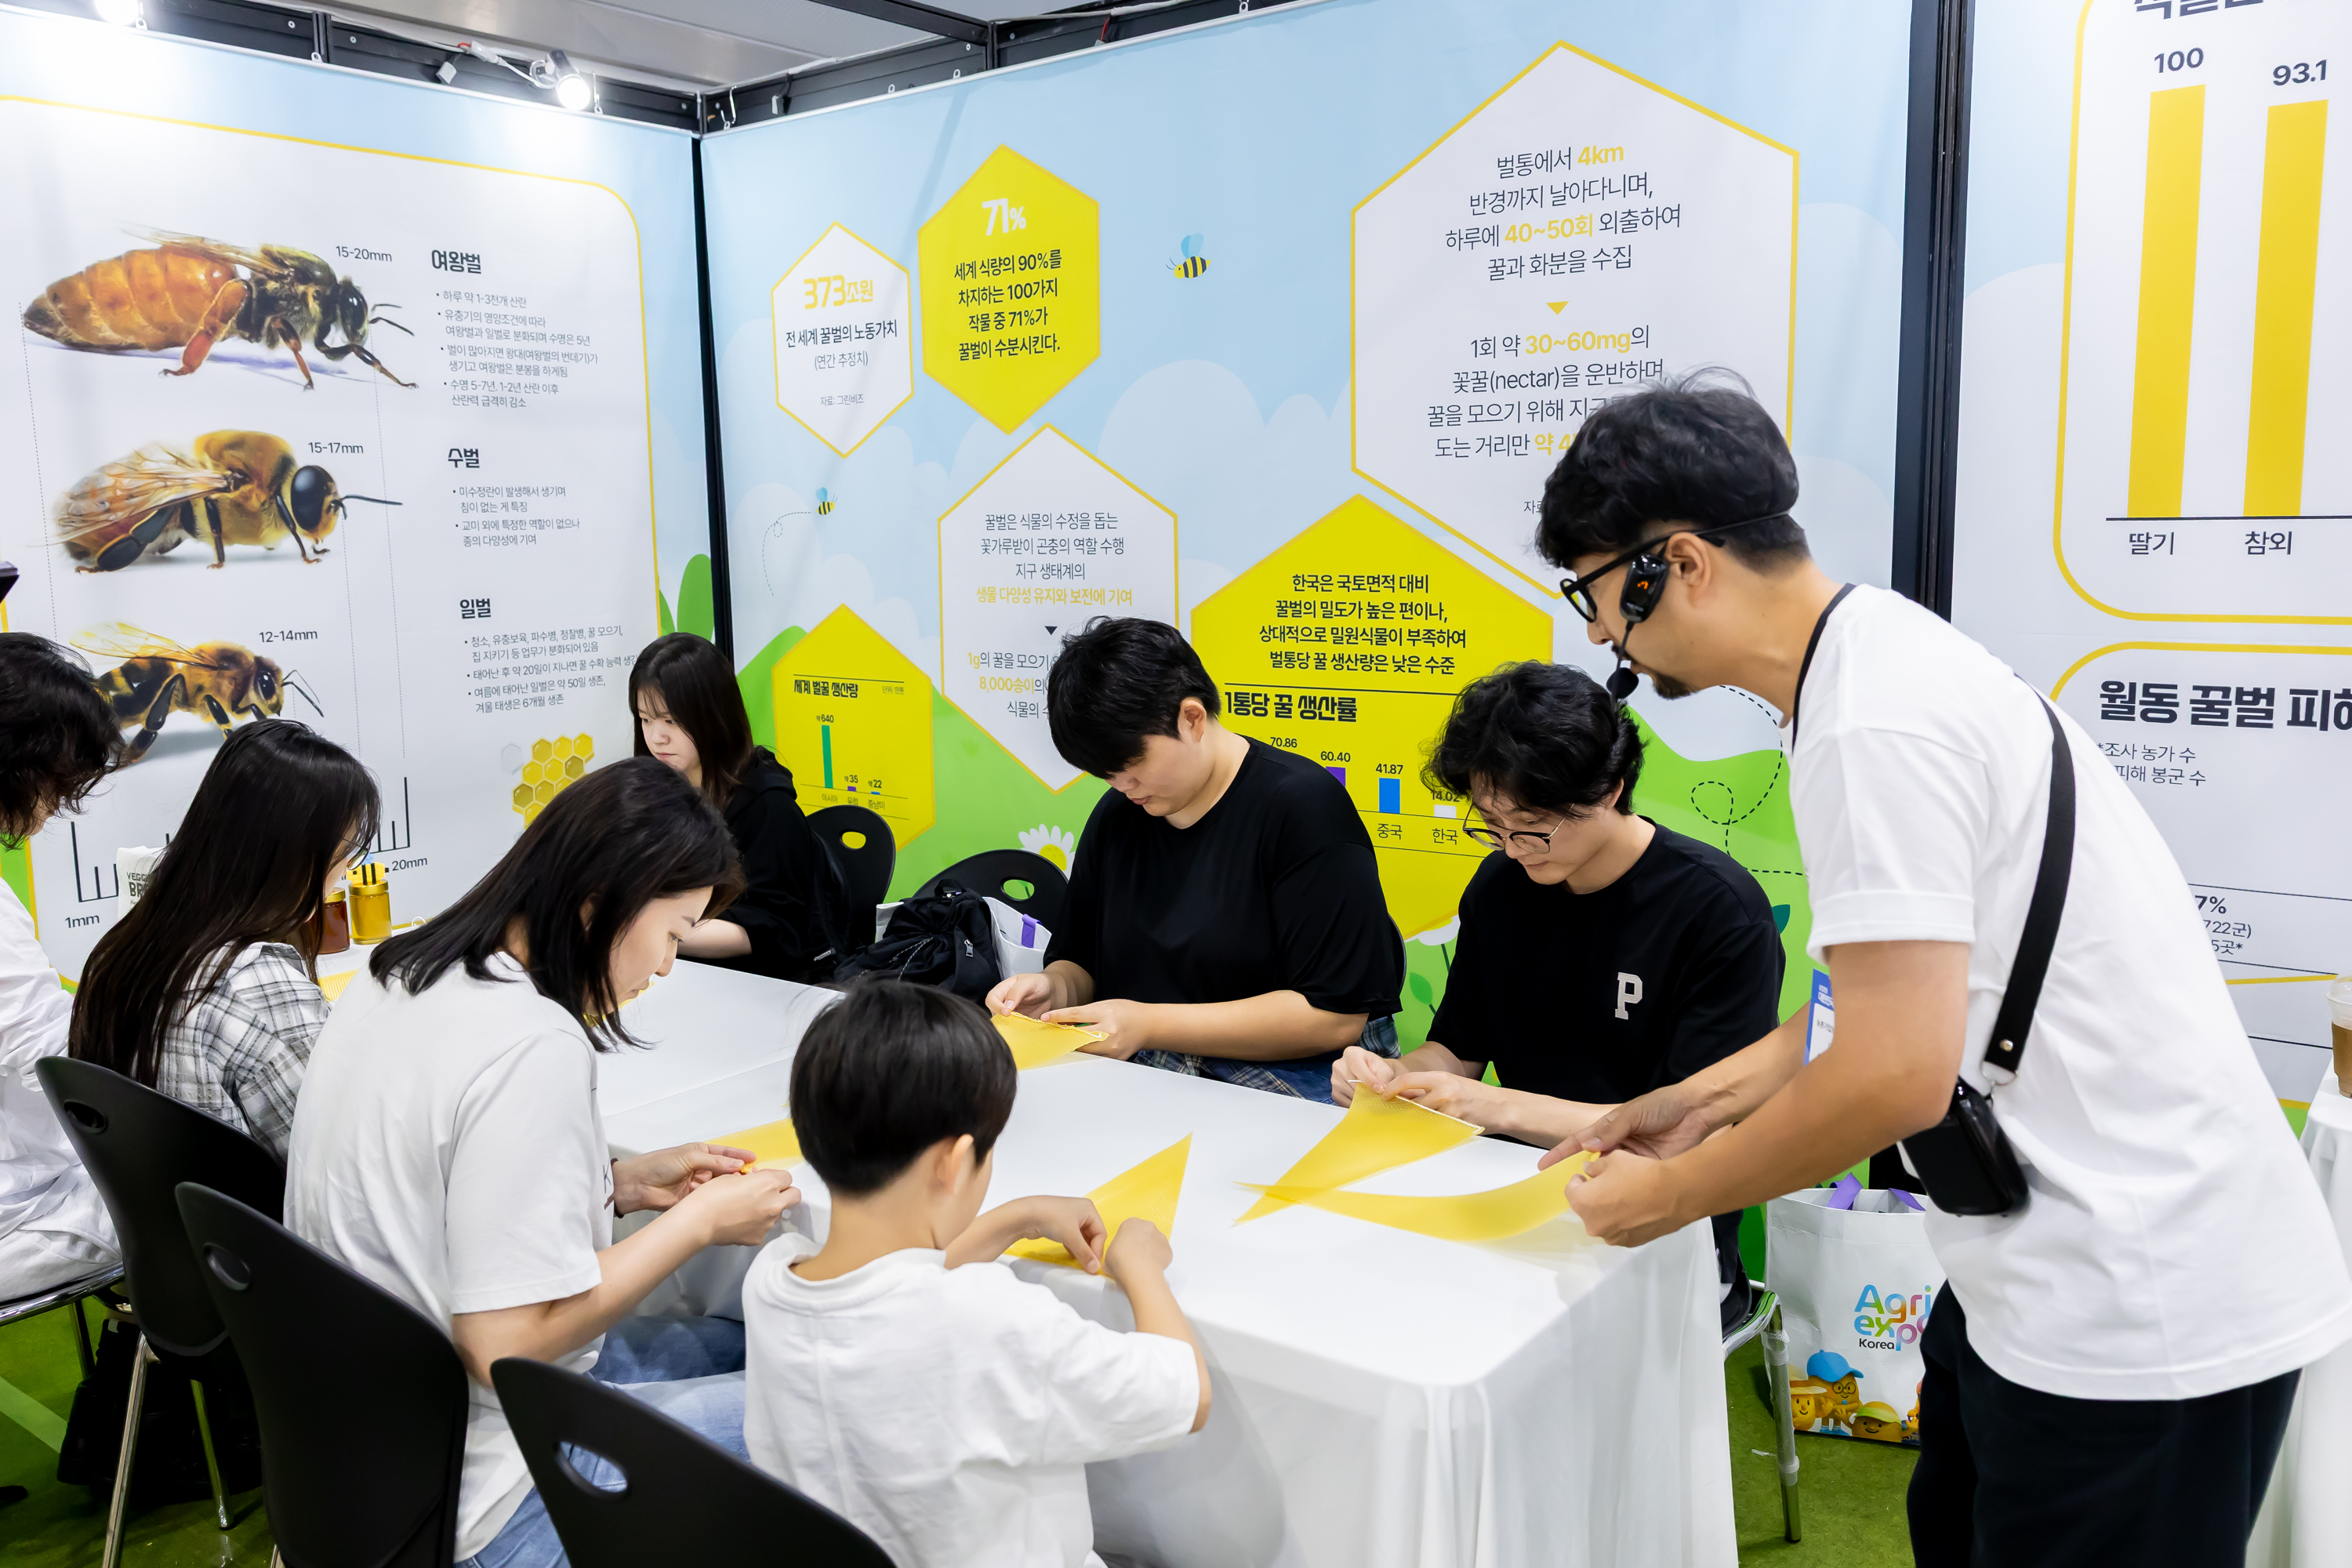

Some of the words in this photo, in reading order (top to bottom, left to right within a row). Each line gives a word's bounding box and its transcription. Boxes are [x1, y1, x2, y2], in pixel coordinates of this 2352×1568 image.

[2154, 48, 2204, 73] 100
[2273, 60, 2327, 85] 93.1
[1497, 147, 1571, 179] 벌통에서
[1577, 145, 1624, 165] 4km
[1470, 185, 1543, 216] 반경까지
[1551, 172, 1653, 206] 날아다니며,
[982, 198, 1026, 236] 71%
[1446, 224, 1499, 251] 하루에
[1504, 213, 1593, 243] 40~50회
[1599, 204, 1680, 234] 외출하여
[336, 245, 392, 262] 15-20mm
[431, 250, 481, 274] 여왕벌
[1488, 256, 1525, 281] 꿀과
[1530, 250, 1587, 276] 화분을
[1592, 245, 1631, 270] 수집
[954, 260, 977, 281] 세계
[979, 255, 1014, 277] 식량의
[1018, 249, 1062, 271] 90%를
[443, 290, 463, 303] 하루
[464, 292, 474, 303] 약
[510, 296, 527, 309] 산란
[804, 274, 873, 310] 373조원
[959, 285, 1004, 307] 차지하는
[1007, 278, 1058, 299] 100가지
[969, 313, 991, 332] 작물
[993, 311, 1006, 330] 중
[1008, 307, 1048, 327] 71%가
[445, 325, 483, 339] 여왕벌과
[485, 328, 511, 340] 일벌로
[786, 331, 796, 348] 전
[798, 328, 818, 346] 세계
[820, 325, 851, 344] 꿀벌의
[855, 319, 897, 339] 노동가치
[1471, 336, 1496, 358] 1회
[1502, 335, 1521, 357] 약
[1525, 325, 1650, 354] 30~60mg의
[959, 339, 992, 361] 꿀벌이
[995, 333, 1060, 358] 수분시킨다.
[815, 354, 836, 371] (연간
[838, 350, 868, 368] 추정치)
[1453, 365, 1581, 394] 꽃꿀(nectar)을
[1428, 405, 1463, 427] 꿀을
[1468, 401, 1520, 423] 모으기
[1526, 399, 1563, 422] 위해
[308, 442, 364, 453] 15-17mm
[1435, 437, 1471, 458] 도는
[1475, 434, 1530, 457] 거리만
[1534, 433, 1554, 456] 약
[448, 448, 480, 468] 수벌
[459, 486, 503, 498] 미수정란이
[505, 486, 539, 498] 발생해서
[541, 486, 565, 497] 생기며
[460, 502, 478, 514] 침이
[480, 502, 498, 513] 없는
[500, 502, 509, 512] 게
[511, 501, 528, 513] 특징
[985, 514, 1017, 531] 꿀벌은
[1020, 513, 1052, 530] 식물의
[1056, 513, 1091, 530] 수정을
[1094, 513, 1118, 529] 돕는
[463, 535, 481, 547] 종의
[483, 535, 518, 546] 다양성에
[520, 534, 536, 545] 기여
[981, 538, 1033, 555] 꽃가루받이
[1036, 538, 1069, 555] 곤충의
[1073, 537, 1098, 555] 역할
[1100, 537, 1123, 555] 수행
[2129, 532, 2174, 555] 딸기
[2245, 531, 2292, 555] 참외
[1016, 563, 1037, 579] 지구
[1040, 563, 1085, 580] 생태계의
[1292, 574, 1334, 592] 한국은
[1337, 574, 1395, 593] 국토면적
[1399, 575, 1428, 593] 대비
[976, 586, 997, 603] 생물
[1000, 586, 1031, 604] 다양성
[1033, 587, 1068, 604] 유지와
[1069, 588, 1105, 605] 보전에
[1109, 588, 1132, 606] 기여
[459, 598, 491, 619] 일벌
[1276, 600, 1316, 619] 꿀벌의
[1320, 601, 1363, 619] 밀도가
[1366, 601, 1396, 619] 높은
[1399, 601, 1447, 623] 편이나,
[259, 630, 318, 643] 12-14mm
[588, 627, 595, 638] 꿀
[1259, 625, 1327, 644] 상대적으로
[1330, 626, 1402, 646] 밀원식물이
[1406, 629, 1465, 648] 부족하여
[472, 652, 481, 662] 집
[483, 649, 509, 661] 지키기
[511, 648, 520, 659] 등
[521, 646, 546, 659] 업무가
[549, 643, 581, 656] 분화되어
[583, 641, 598, 652] 있음
[967, 652, 990, 670] 1g의
[993, 652, 1014, 669] 꿀을
[1017, 655, 1049, 671] 모으기
[1270, 651, 1311, 670] 벌통당
[1313, 652, 1327, 670] 꿀
[1330, 653, 1388, 672] 생산량은
[1392, 655, 1421, 673] 낮은
[1425, 656, 1455, 675] 수준
[794, 679, 811, 695] 세계
[812, 681, 829, 696] 벌꿀
[831, 682, 858, 699] 생산량
[979, 676, 1045, 695] 8,000송이의
[1007, 701, 1039, 719] 식물의
[1225, 691, 1270, 717] 1통당
[1274, 694, 1293, 719] 꿀
[1298, 695, 1357, 722] 생산률
[2100, 681, 2180, 724] 월동
[2190, 685, 2275, 728] 꿀벌
[1270, 737, 1298, 749] 70.86
[1320, 751, 1351, 762] 60.40
[2141, 745, 2175, 762] 농가
[2179, 747, 2196, 764] 수
[1375, 764, 1403, 775] 41.87
[2151, 767, 2184, 785] 봉군
[2189, 771, 2206, 786] 수
[1377, 823, 1403, 840] 중국
[1432, 828, 1458, 845] 한국
[392, 858, 427, 871] 20mm
[65, 915, 100, 928] 1mm
[1615, 972, 1642, 1020] P
[1854, 1284, 1931, 1323] Agri
[1859, 1338, 1894, 1349] Korea
